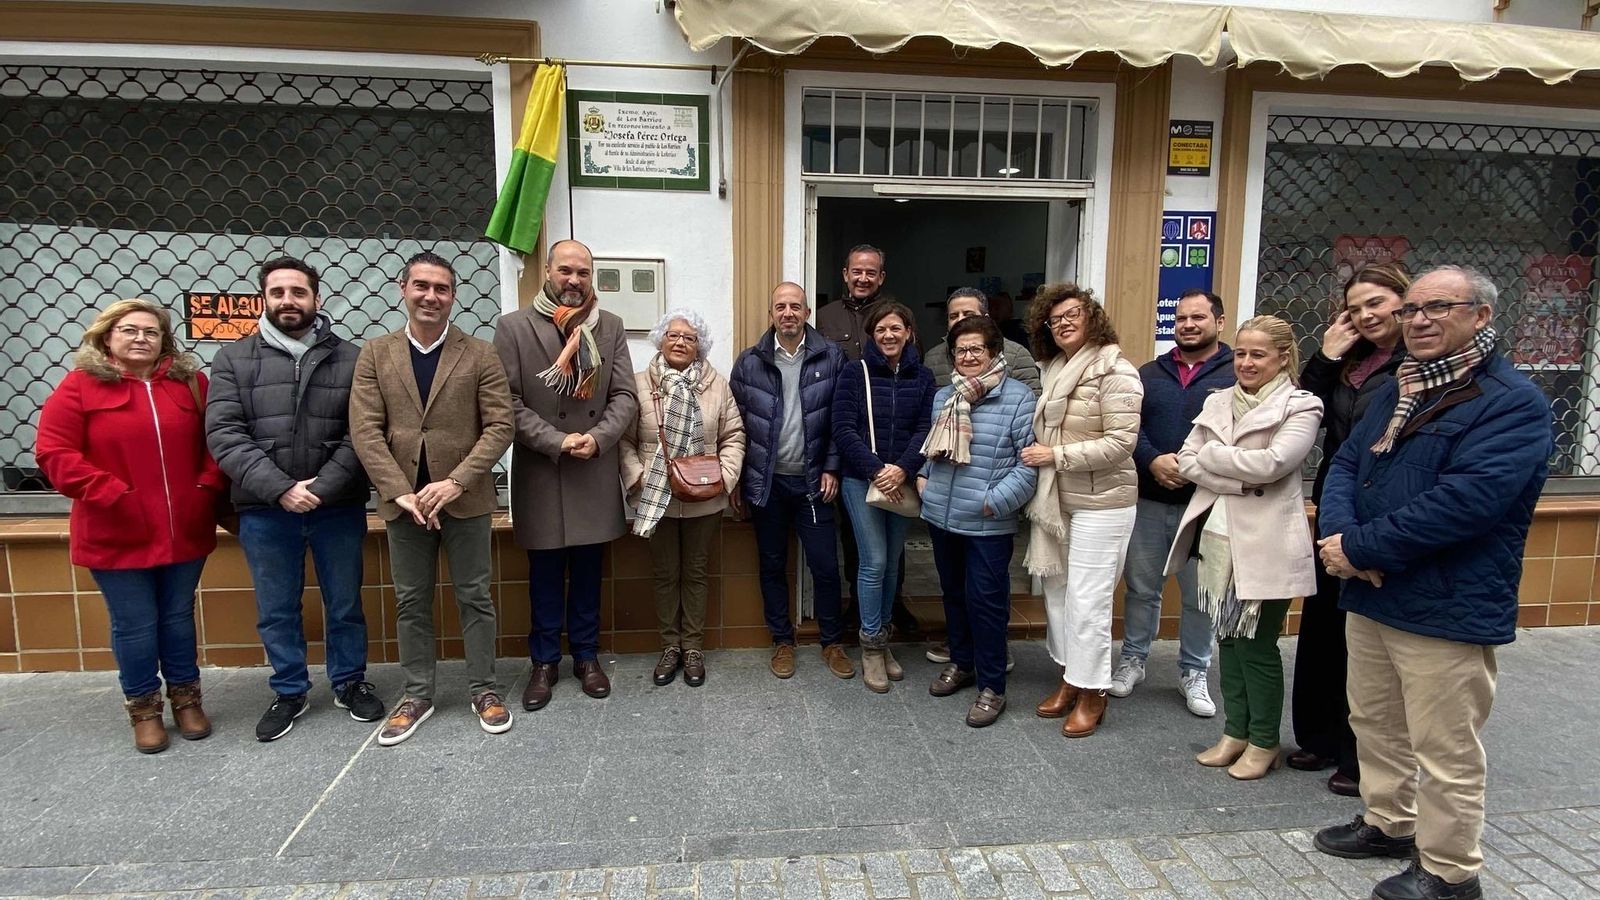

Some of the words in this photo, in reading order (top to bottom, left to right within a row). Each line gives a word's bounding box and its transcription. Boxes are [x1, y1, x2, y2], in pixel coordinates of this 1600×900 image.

[637, 131, 658, 140] Pérez
[660, 133, 687, 144] Ortega
[190, 296, 212, 314] SE
